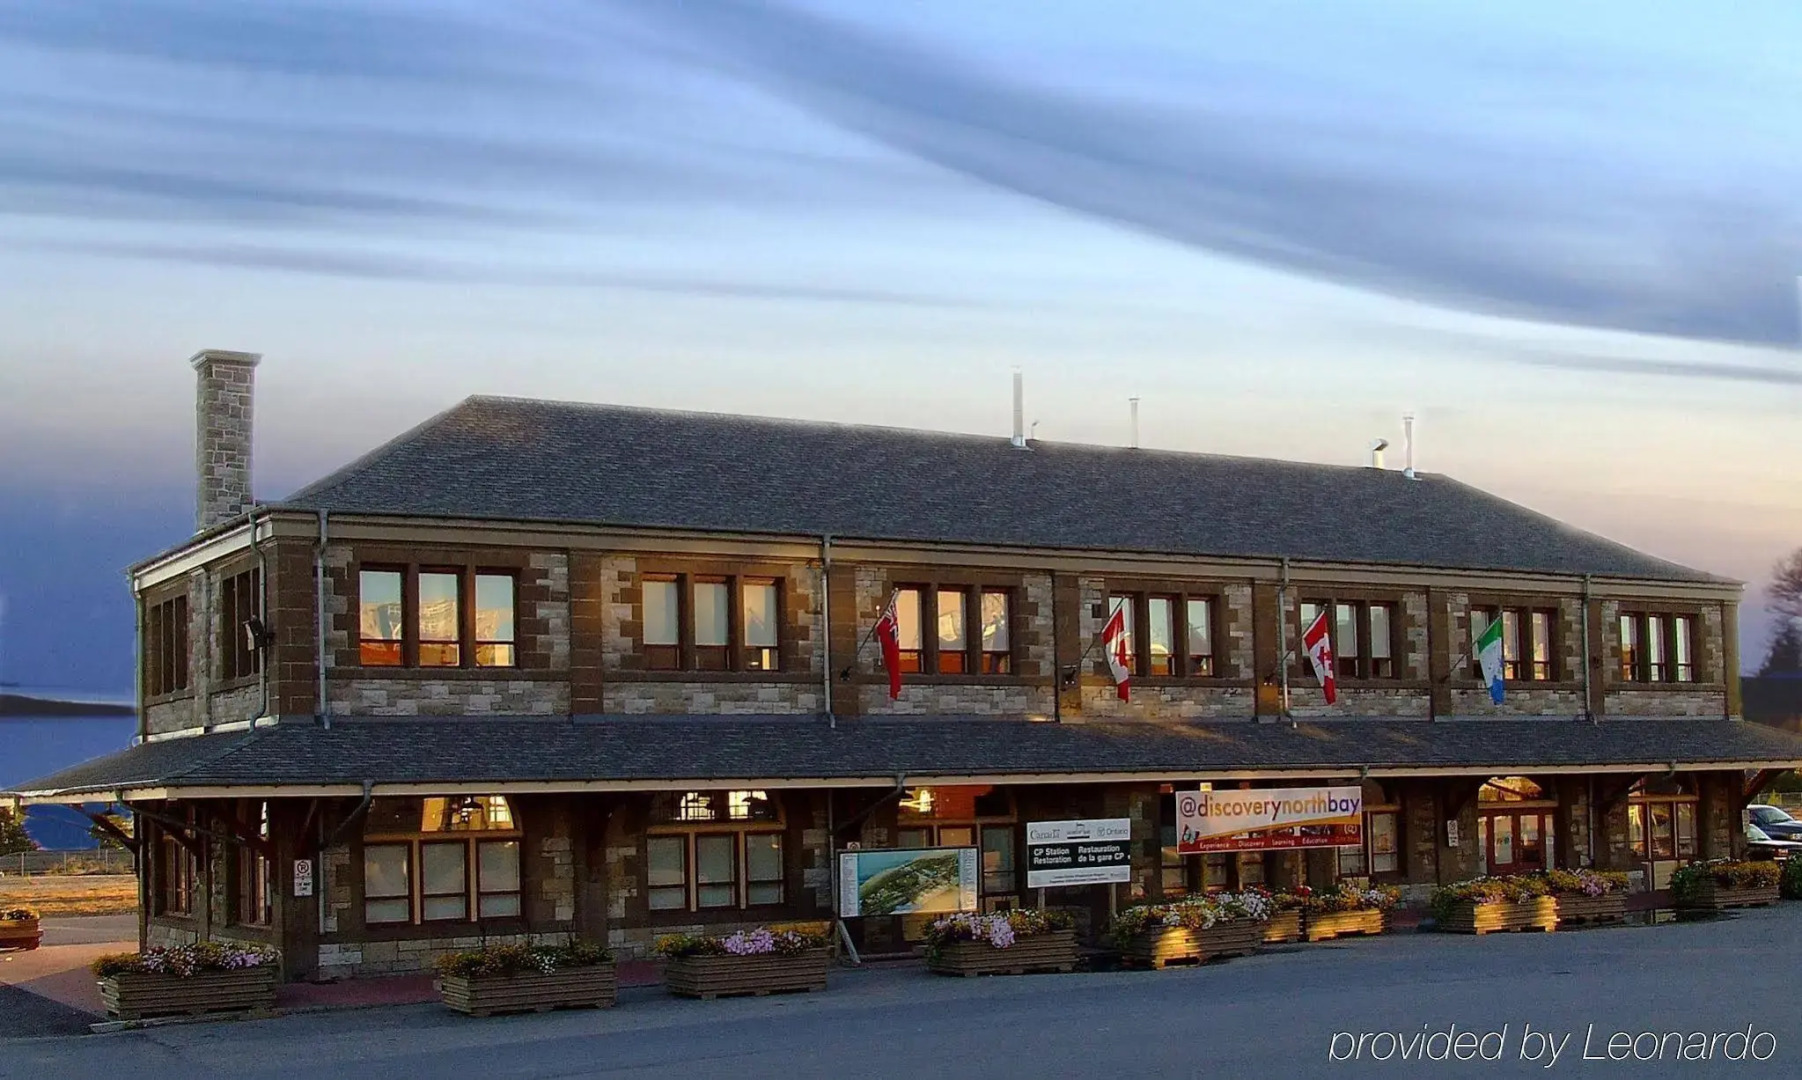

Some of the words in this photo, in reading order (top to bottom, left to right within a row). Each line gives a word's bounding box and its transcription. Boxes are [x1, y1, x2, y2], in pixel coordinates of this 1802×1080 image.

[1179, 792, 1360, 820] @discoverynorthbay
[1200, 841, 1230, 850] Experience
[1238, 840, 1265, 848] Discovery
[1272, 838, 1295, 847] Learning
[1302, 837, 1328, 845] Education
[1045, 847, 1070, 856] Station
[1078, 845, 1120, 853] Restauration
[1033, 856, 1072, 864] Restoration
